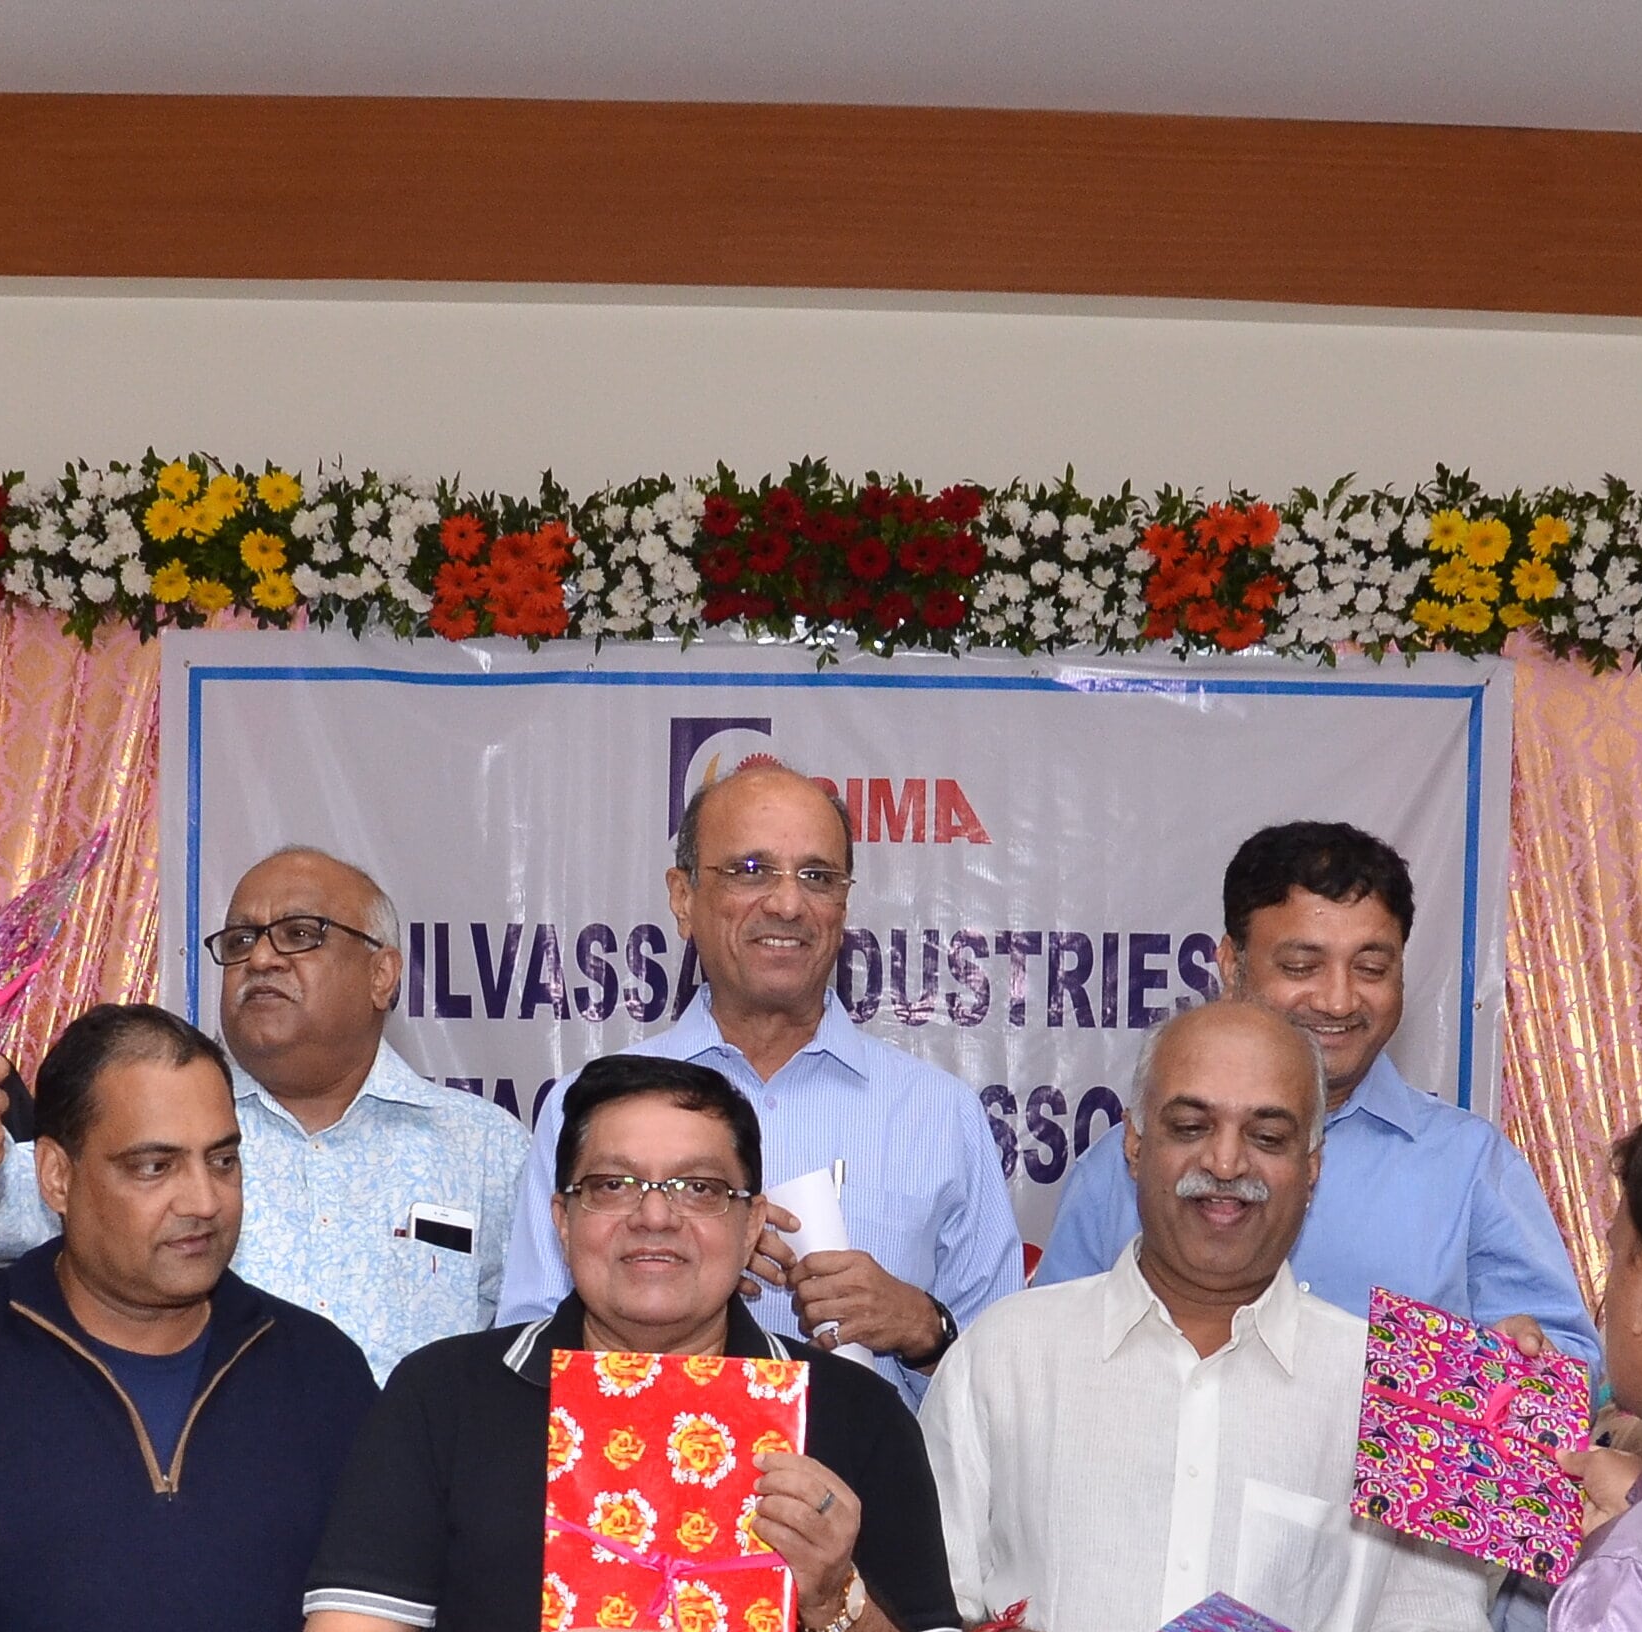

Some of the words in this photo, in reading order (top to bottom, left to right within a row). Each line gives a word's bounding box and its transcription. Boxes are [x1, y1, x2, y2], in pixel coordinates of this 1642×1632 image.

[811, 776, 993, 845] IMA
[389, 921, 710, 1023] ILVASSA
[835, 927, 1222, 1030] DUSTRIES
